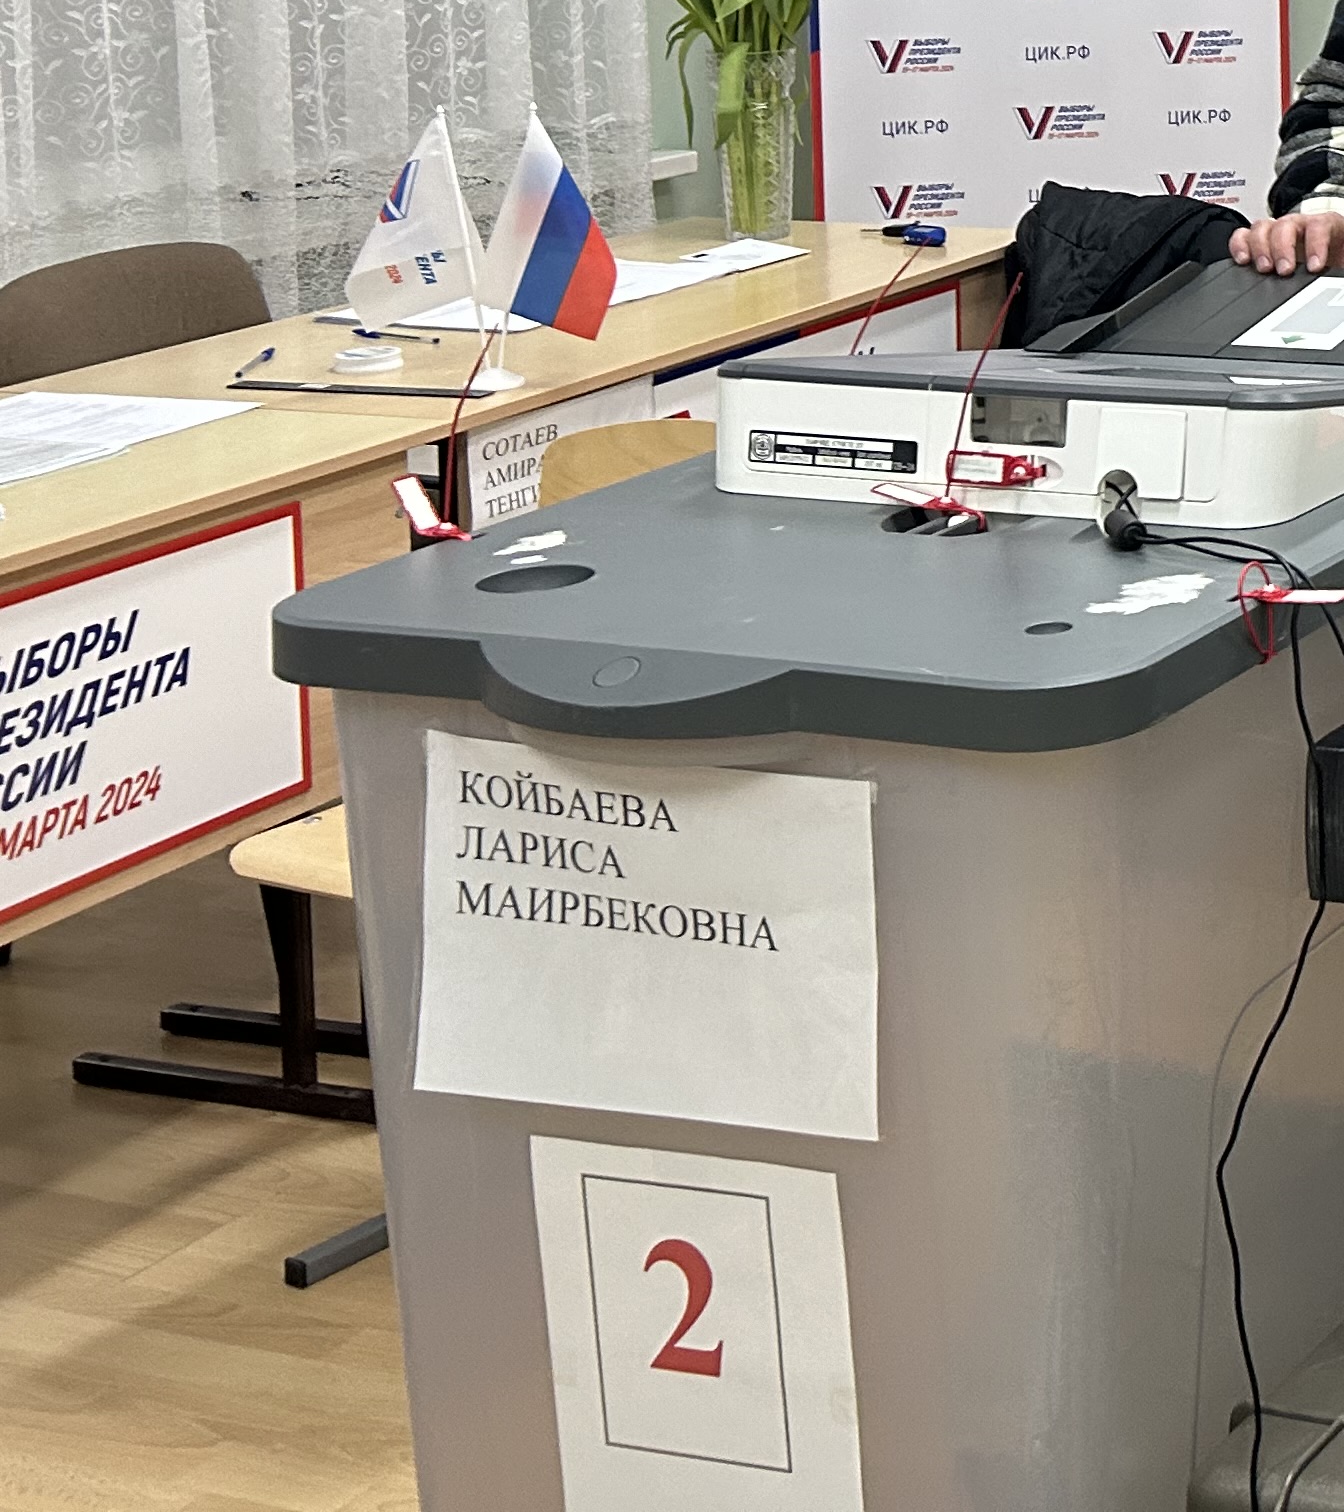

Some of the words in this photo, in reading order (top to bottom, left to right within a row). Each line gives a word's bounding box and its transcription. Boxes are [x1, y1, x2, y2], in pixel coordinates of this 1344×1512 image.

[1024, 44, 1090, 62] ЦИК.РФ
[881, 119, 949, 137] ЦИК.РФ
[1167, 108, 1232, 127] ЦИК.РФ
[482, 424, 558, 460] СОТАЕВ
[0, 609, 139, 694] ЫБОРЫ
[0, 647, 190, 755] ЕЗИДЕНТА
[0, 740, 88, 812] СИИ
[94, 765, 162, 825] 2024
[458, 770, 679, 834] КОЙБАЕВА
[456, 825, 627, 880] ЛАРИСА
[456, 880, 780, 953] МАИРБЕКОВНА
[643, 1238, 724, 1378] 2
